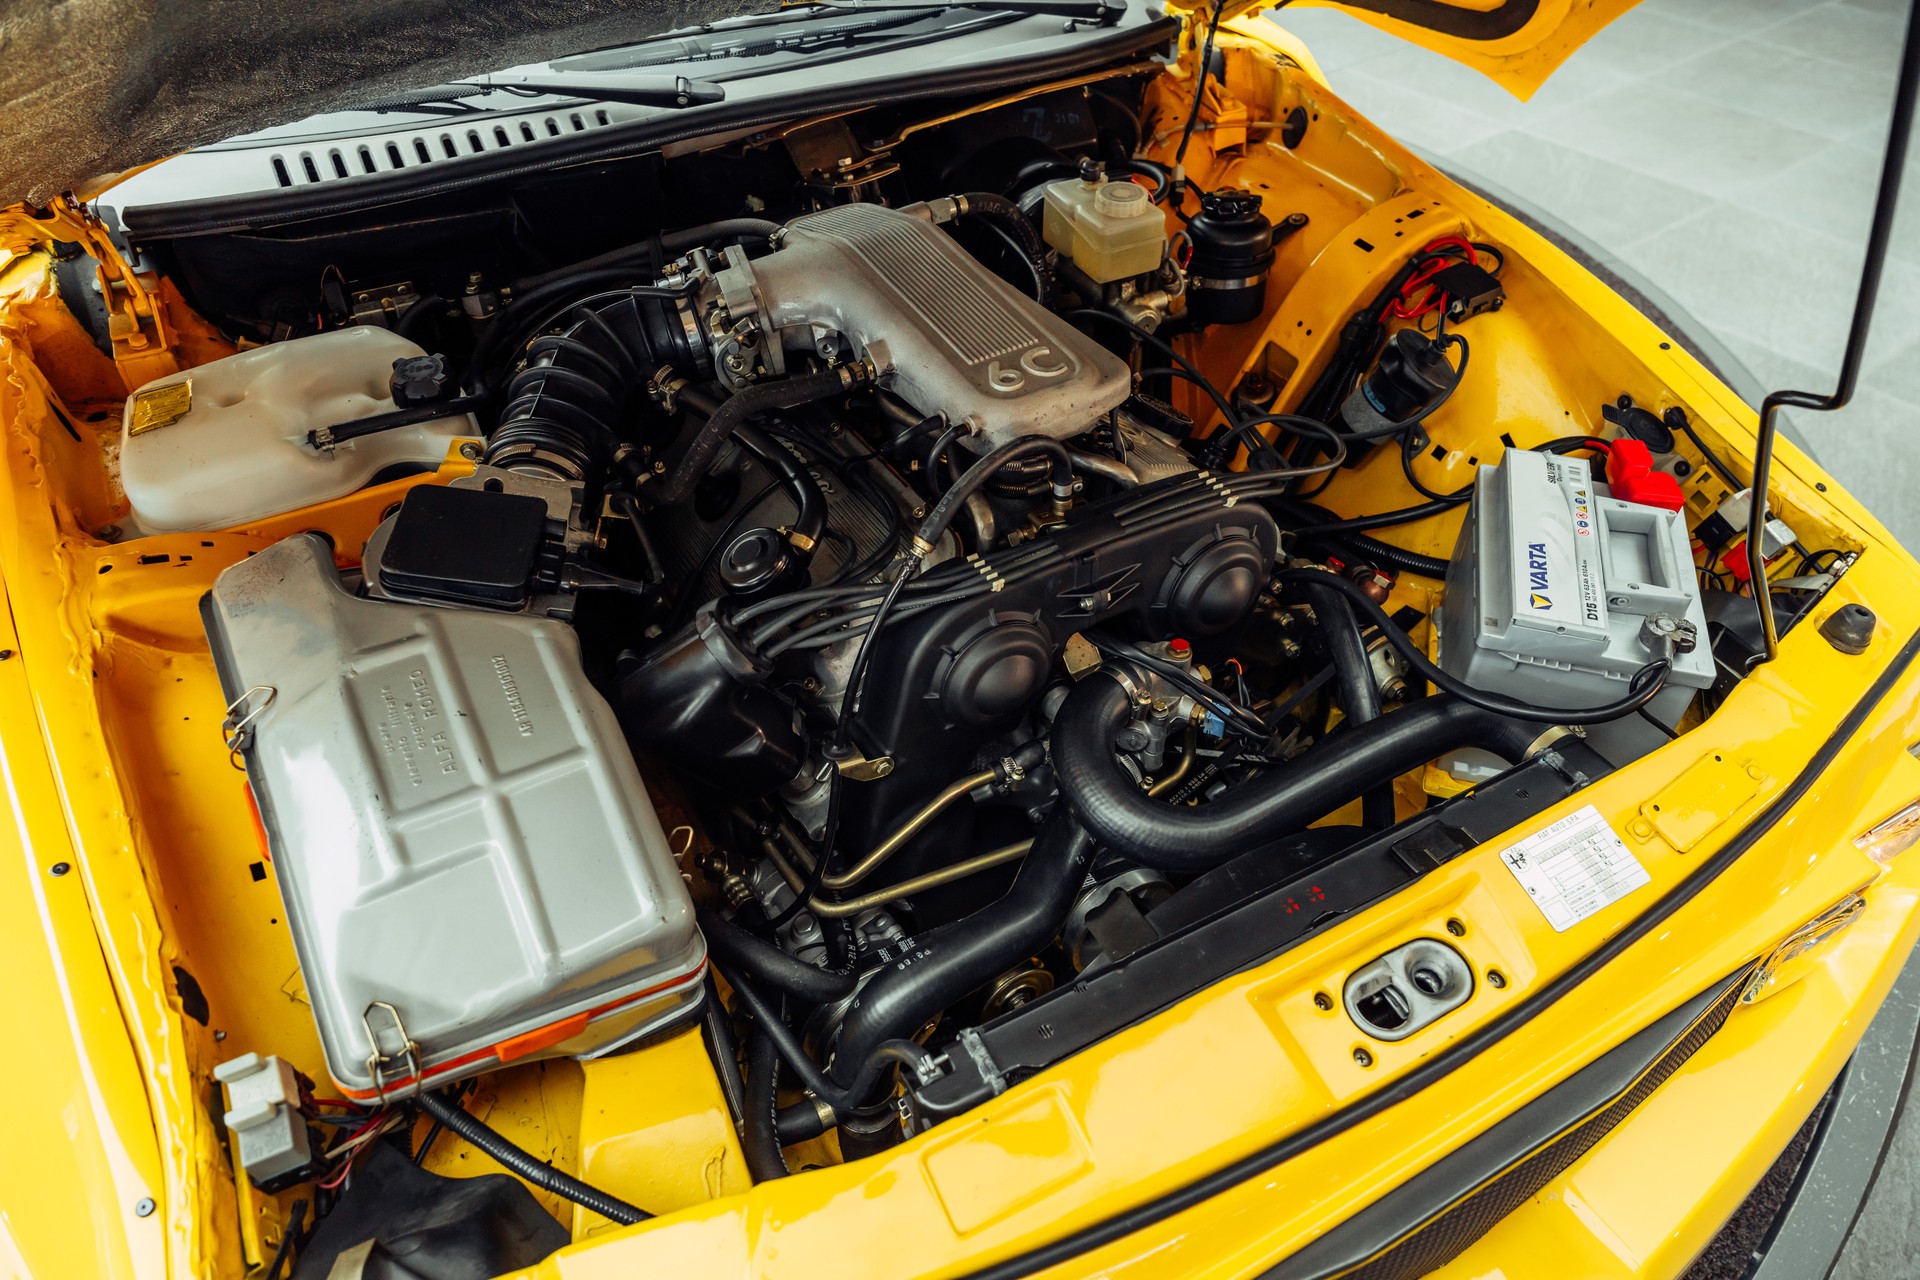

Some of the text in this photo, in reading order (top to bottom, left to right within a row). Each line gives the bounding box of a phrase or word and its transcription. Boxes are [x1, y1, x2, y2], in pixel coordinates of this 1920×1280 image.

[988, 345, 1069, 392] 6C
[1546, 462, 1557, 484] SILVER
[1528, 543, 1549, 591] VARTA
[1586, 602, 1599, 621] D15
[409, 669, 458, 775] ALFA ROMEO
[518, 721, 534, 737] AR
[1537, 830, 1550, 840] FIAT
[1550, 822, 1567, 833] AUTO
